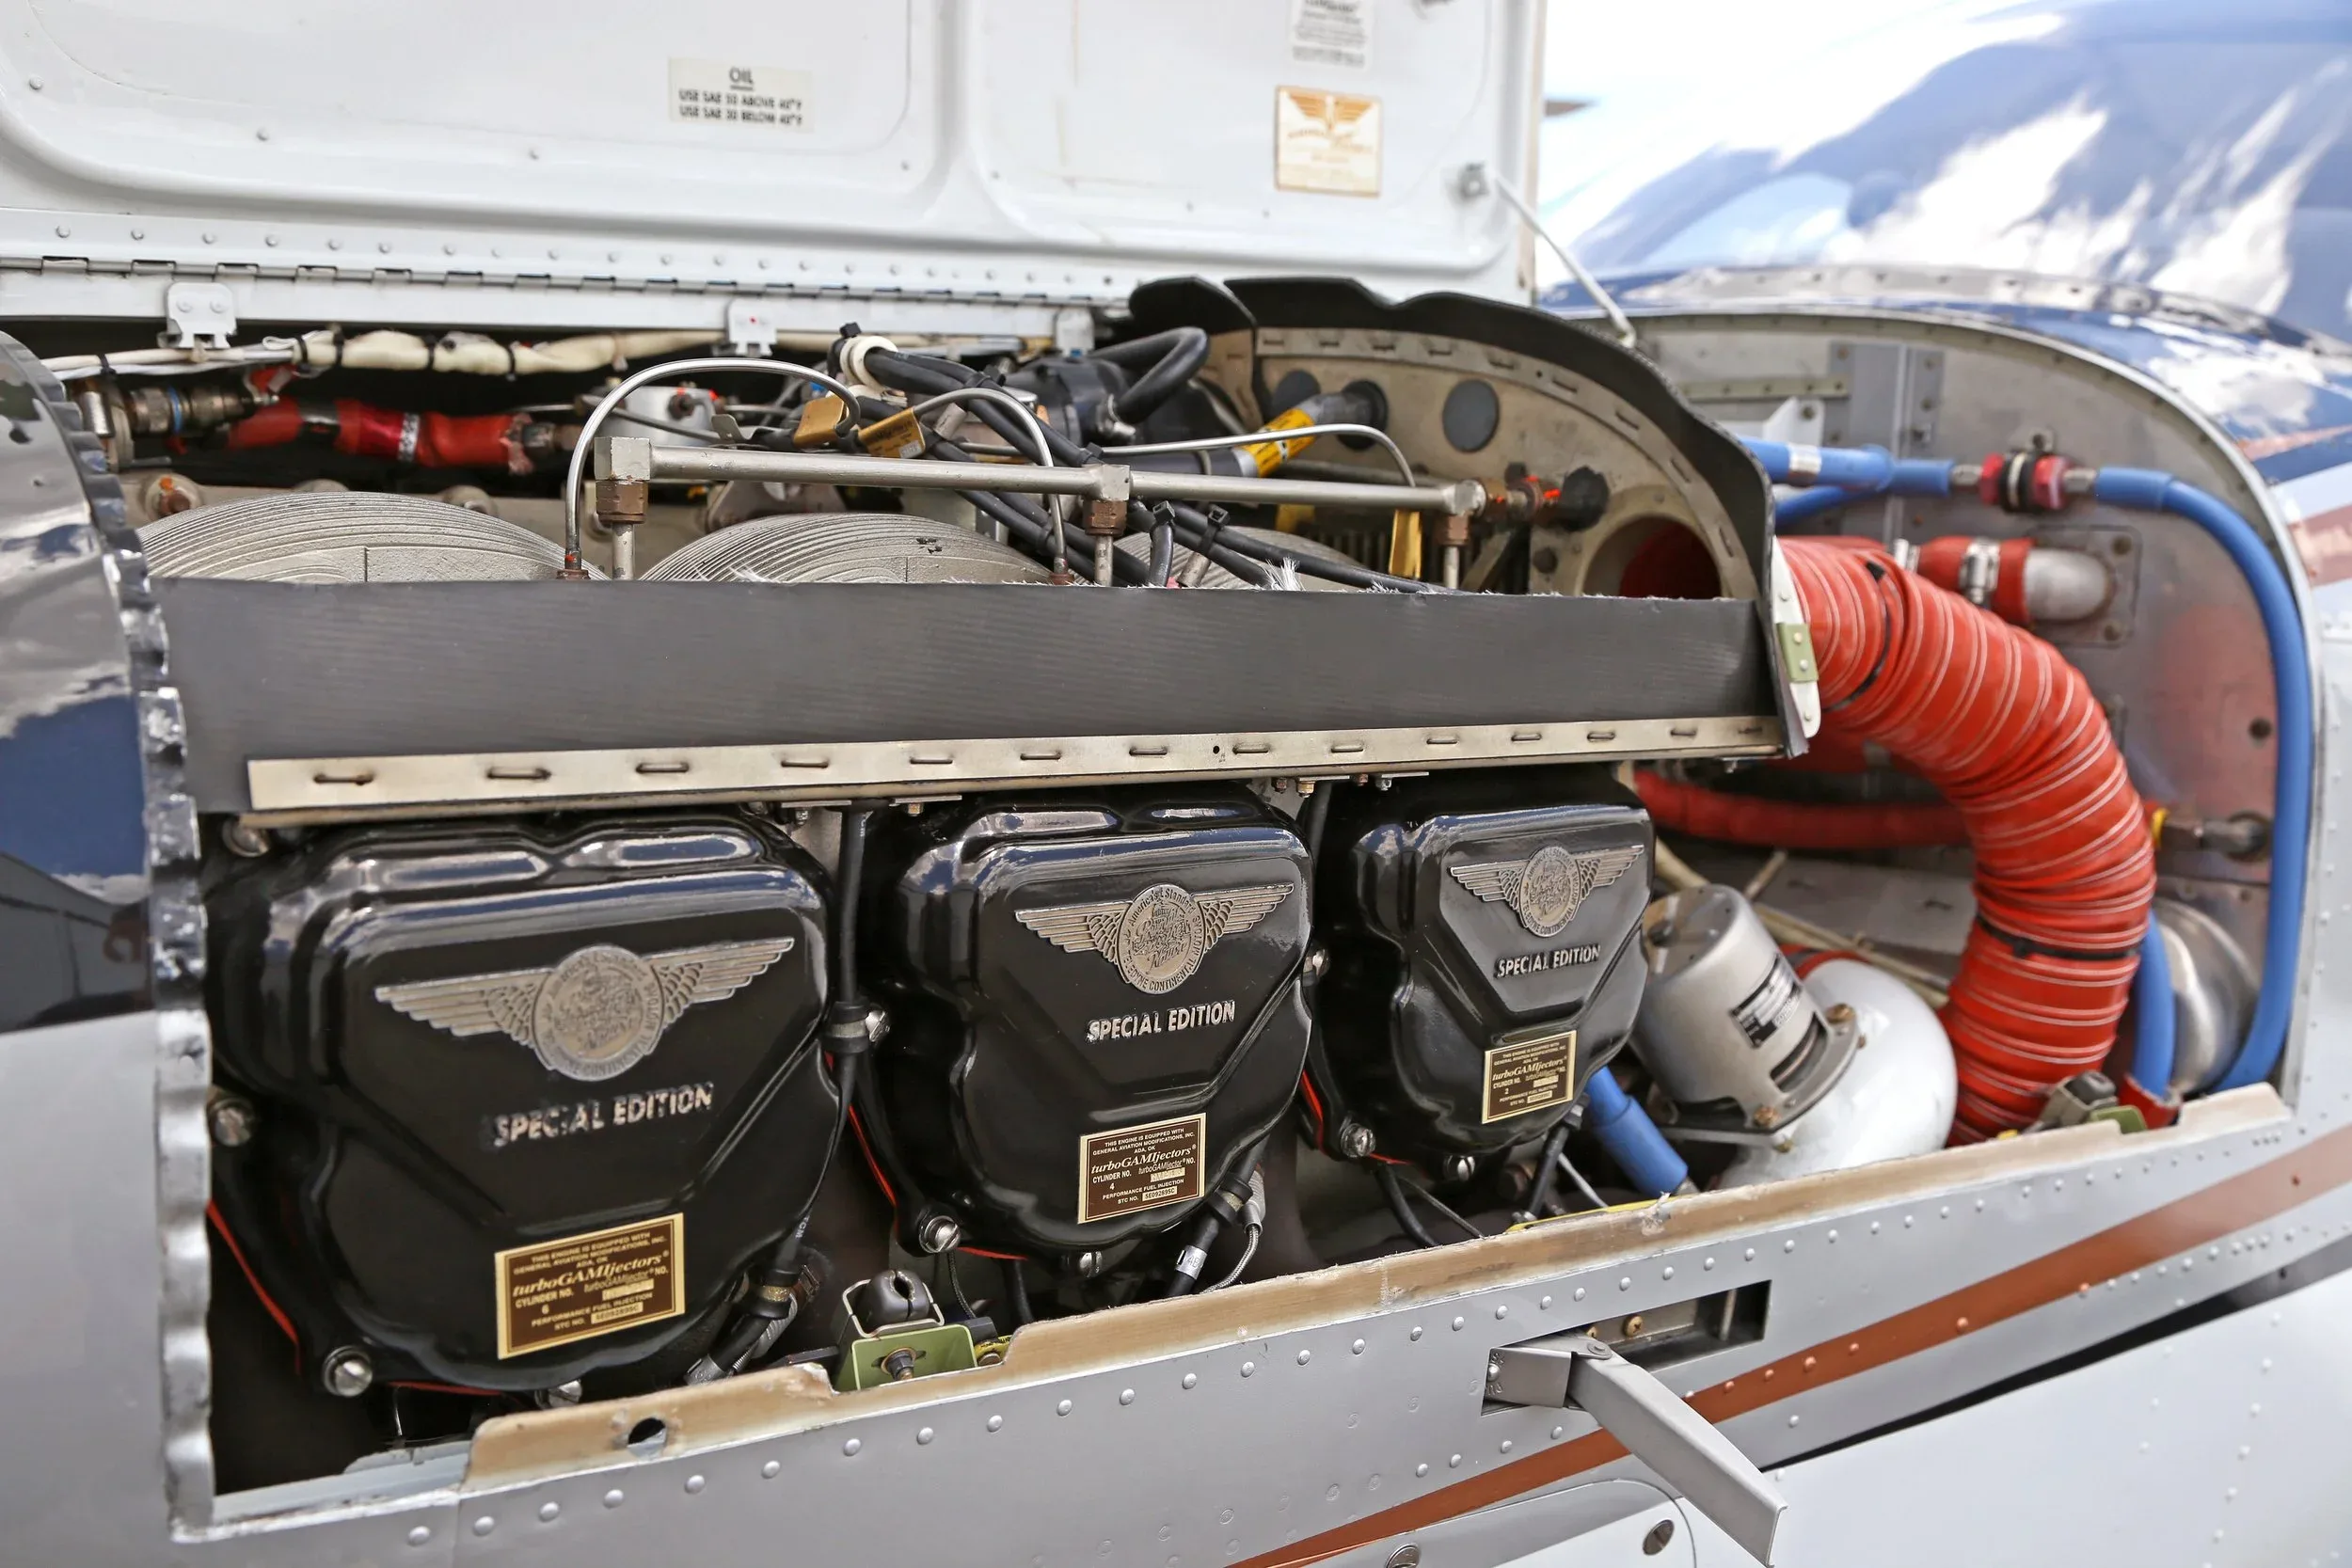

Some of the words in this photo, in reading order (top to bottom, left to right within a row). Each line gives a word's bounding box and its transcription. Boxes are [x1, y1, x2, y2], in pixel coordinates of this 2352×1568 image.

[729, 66, 753, 84] OIL
[678, 88, 698, 103] USE
[741, 95, 774, 109] ABOVE
[679, 104, 698, 118] USE
[741, 111, 774, 124] BELOW
[1149, 958, 1197, 991] CONTINENTAL
[1192, 915, 1203, 957] MOTORS
[1496, 953, 1549, 977] SPECIAL
[1553, 944, 1600, 969] EDITION
[1087, 1011, 1162, 1044] SPECIAL
[1167, 1000, 1236, 1032] EDITION
[493, 1100, 605, 1148] SPECIAL
[612, 1082, 714, 1126] EDITION
[1092, 1147, 1118, 1156] GENERAL
[1119, 1142, 1143, 1150] AVIATION
[1144, 1133, 1184, 1146] MODIFICATIONS,
[1118, 1136, 1137, 1145] ENGINE
[1144, 1131, 1170, 1140] EQUIPPED
[1092, 1172, 1120, 1184] CYLINDER
[1121, 1169, 1132, 1178] NO.
[1102, 1187, 1143, 1200] PERFORMANCE
[1157, 1179, 1184, 1189] INJECTION
[531, 1254, 550, 1262] THIS
[550, 1247, 581, 1259] ENGINE
[591, 1236, 630, 1251] EQUIPPED
[630, 1232, 650, 1242] WITH
[514, 1262, 551, 1275] GENERAL
[552, 1254, 589, 1266] AVIATION
[654, 1265, 669, 1275] NO.
[515, 1291, 558, 1309] CYLINDER
[559, 1287, 575, 1299] NO.
[532, 1307, 591, 1327] PERFORMANCE
[593, 1302, 612, 1311] FUEL
[613, 1292, 653, 1307] INJECTION
[541, 1304, 549, 1314] 6
